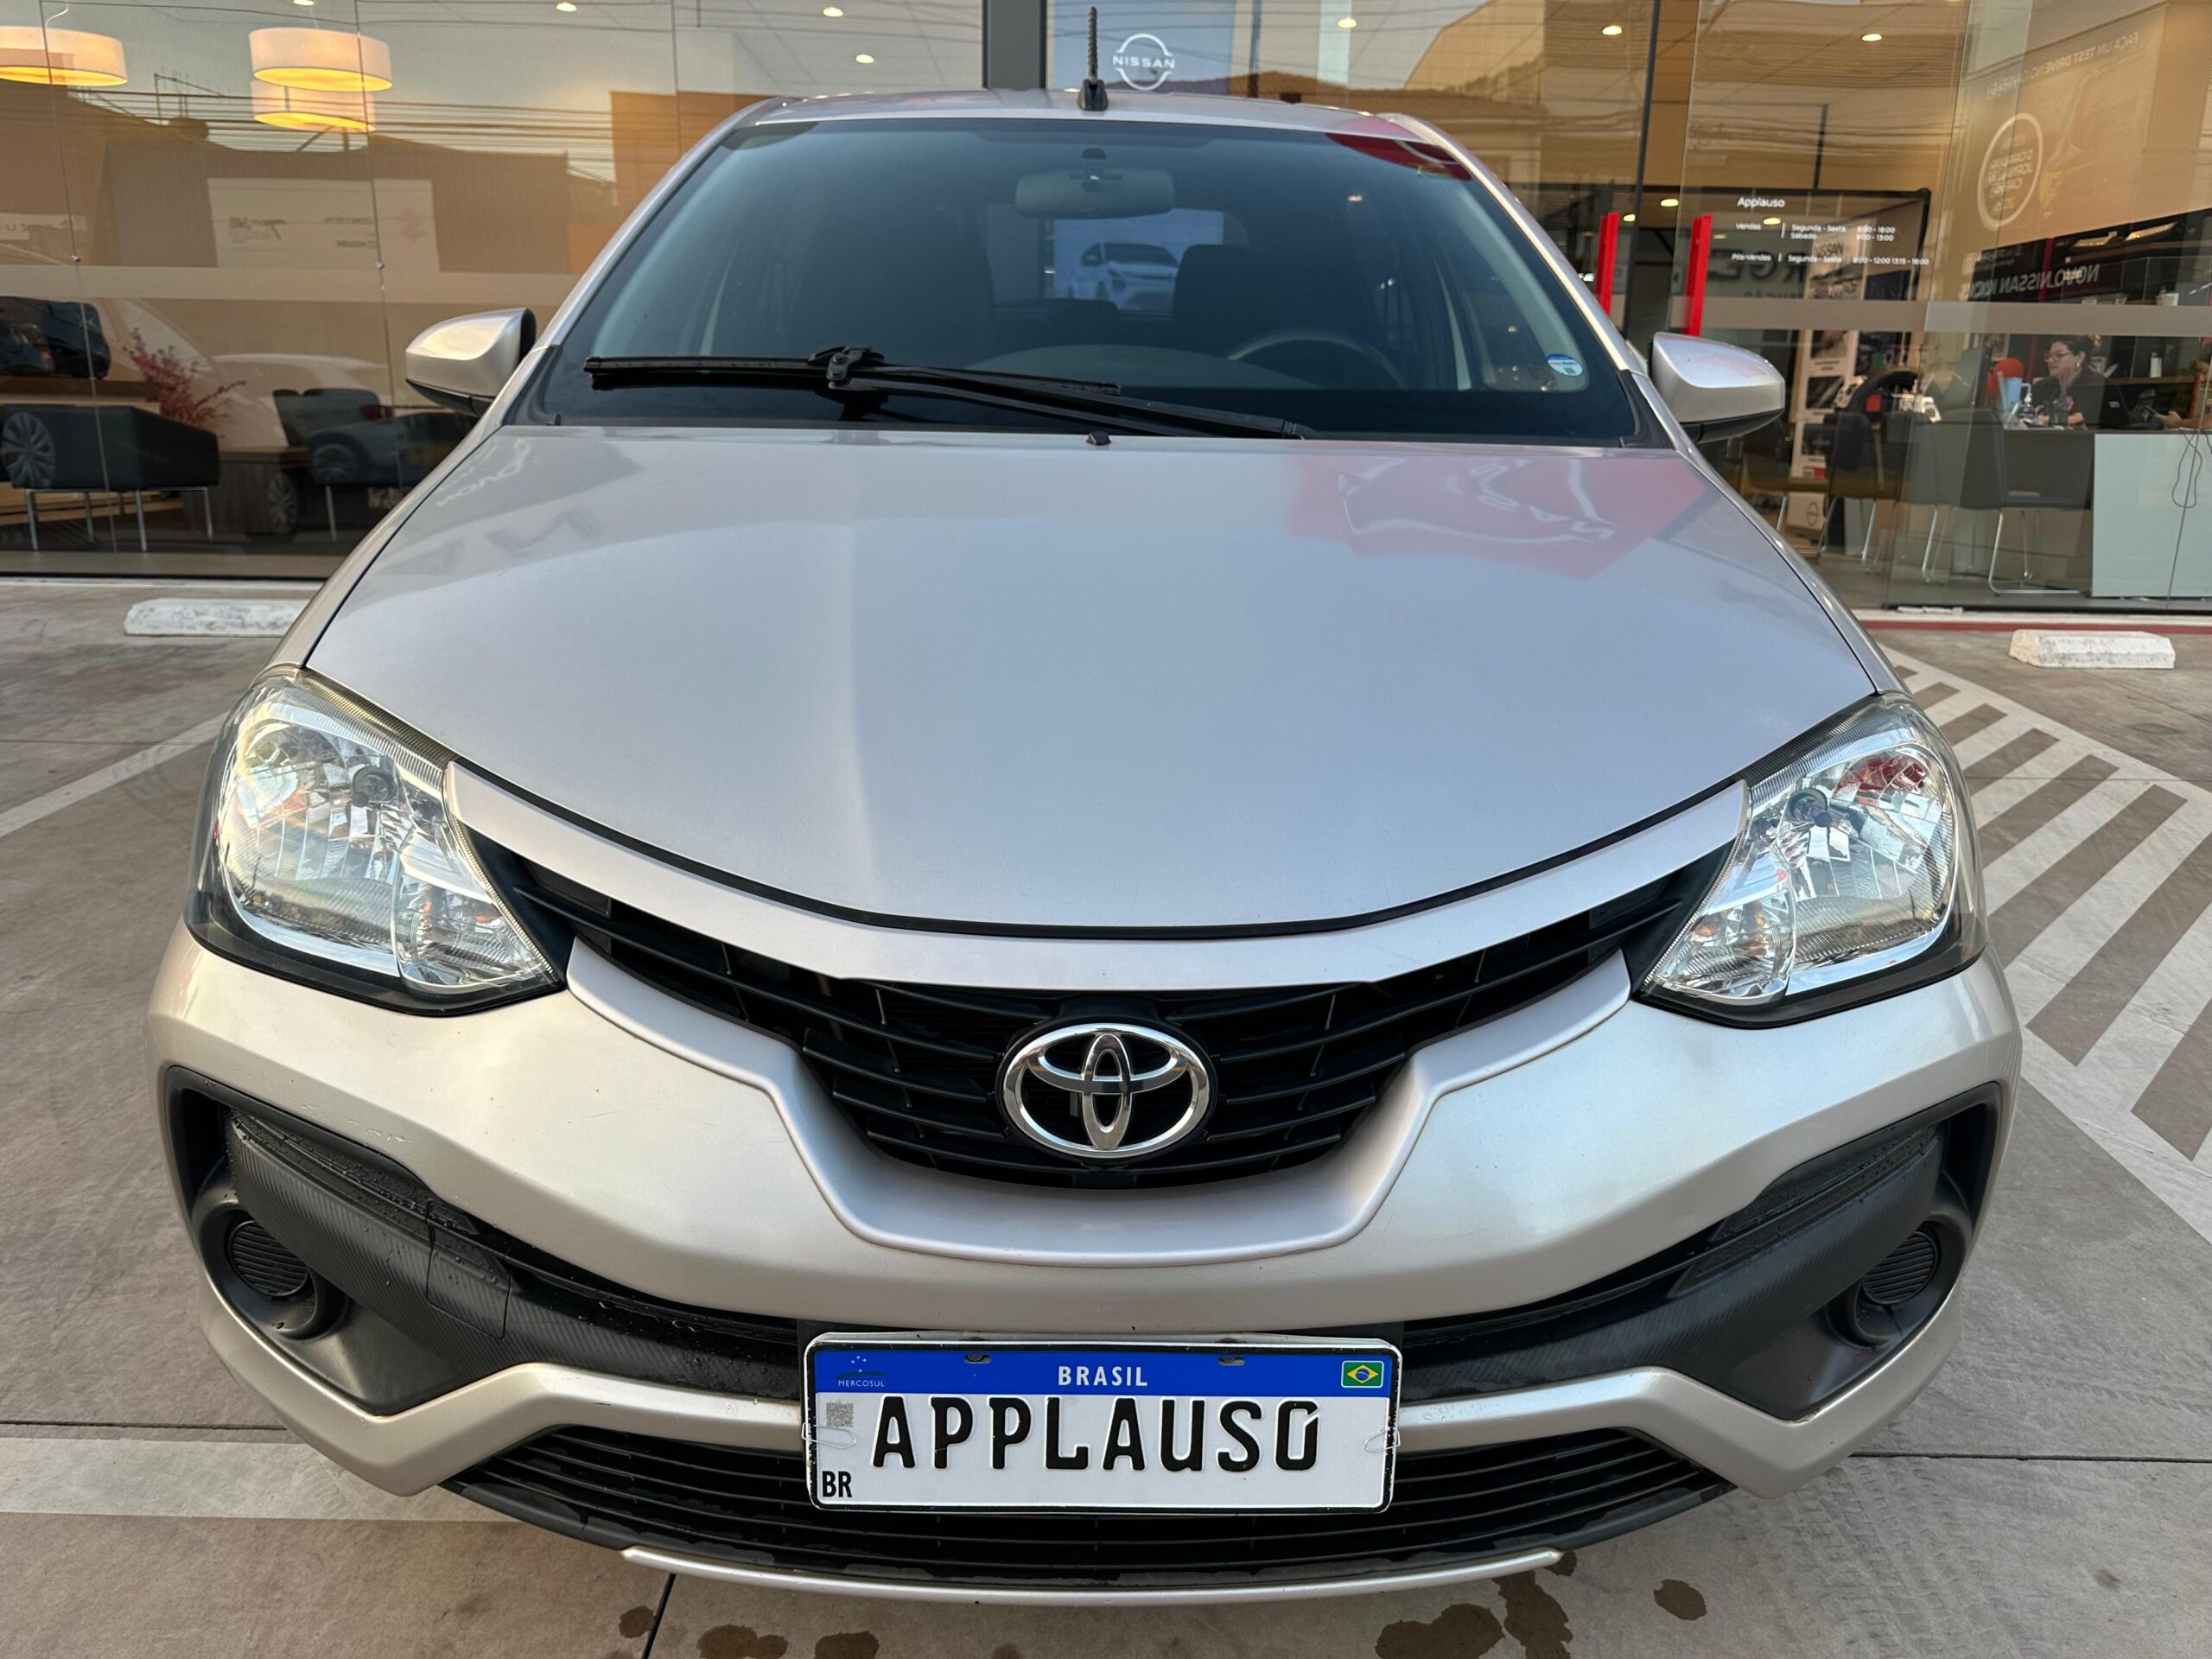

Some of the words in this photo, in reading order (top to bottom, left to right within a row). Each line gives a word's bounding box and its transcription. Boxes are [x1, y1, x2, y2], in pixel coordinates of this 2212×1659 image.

[1112, 55, 1176, 69] NISSAN
[1737, 196, 1786, 208] Applauso
[1735, 222, 1762, 231] Vendas
[1791, 224, 1821, 232] Segunda
[1058, 1365, 1148, 1387] BRASIL
[837, 1379, 886, 1388] MERCOSUL
[872, 1395, 1319, 1472] APPLAUSO
[821, 1470, 854, 1498] BR
